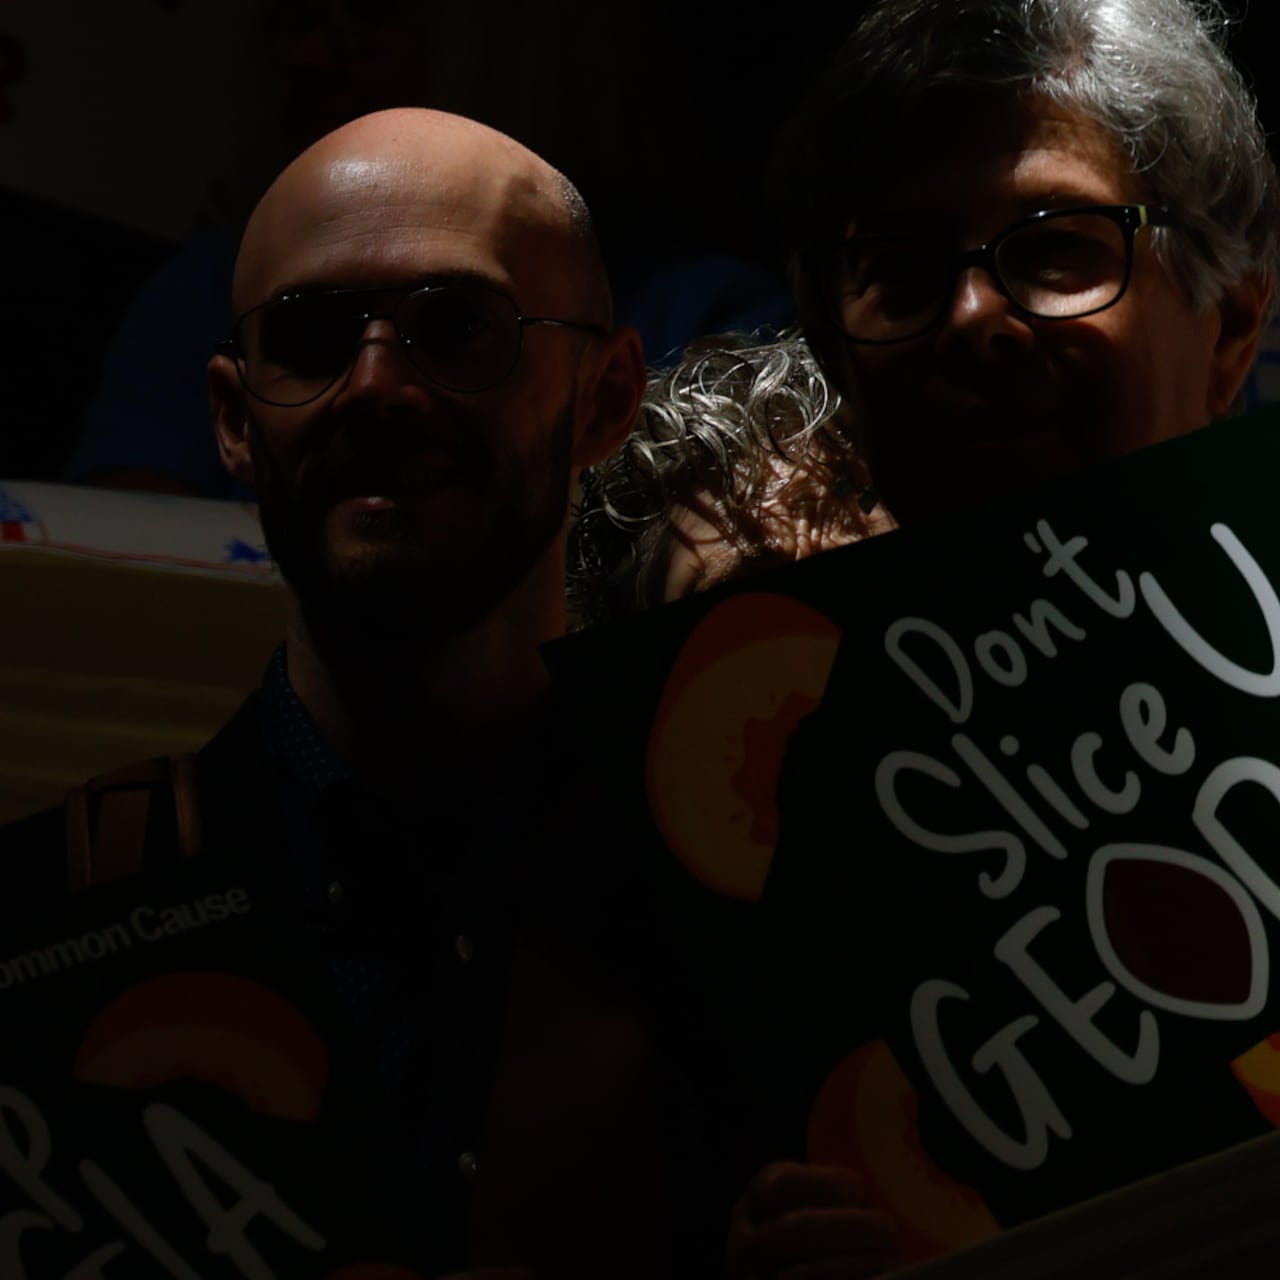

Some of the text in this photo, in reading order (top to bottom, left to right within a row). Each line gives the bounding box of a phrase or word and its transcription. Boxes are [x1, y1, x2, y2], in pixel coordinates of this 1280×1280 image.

[882, 518, 1137, 724] Don't
[873, 680, 1197, 901] Slice
[130, 888, 251, 942] Cause
